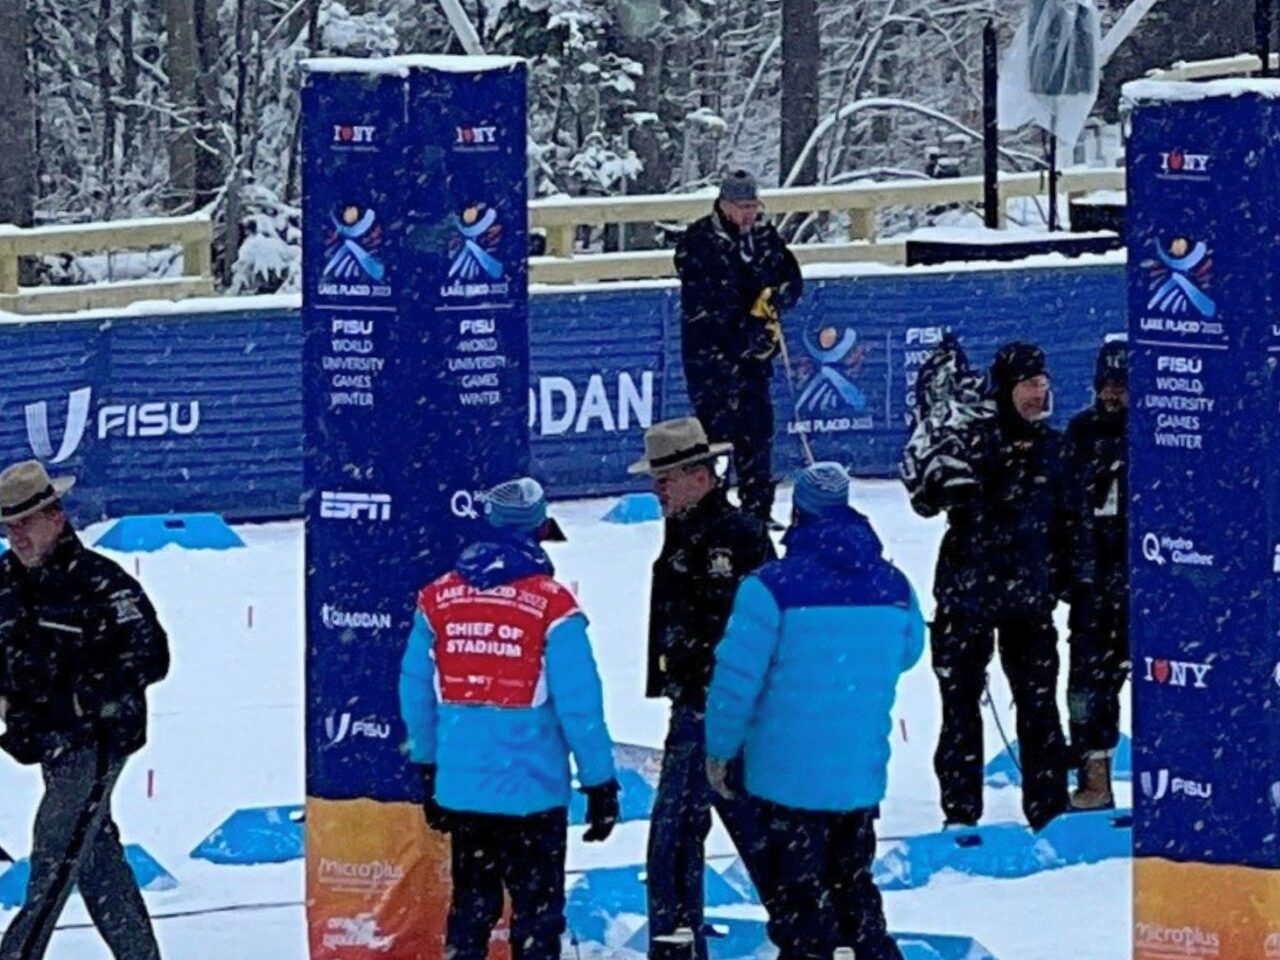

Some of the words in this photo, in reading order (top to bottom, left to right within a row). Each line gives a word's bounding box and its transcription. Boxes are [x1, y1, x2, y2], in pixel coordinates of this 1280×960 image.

[332, 320, 374, 334] FISU
[459, 320, 496, 334] FISU
[332, 339, 373, 353] WORLD
[1157, 357, 1203, 373] FISU
[332, 374, 372, 388] GAMES
[461, 373, 499, 388] GAMES
[1156, 377, 1203, 393] WORLD
[459, 391, 501, 406] WINTER
[1146, 394, 1215, 412] UNIVERSITY
[98, 400, 200, 438] FISU
[787, 419, 812, 434] LAKE
[813, 418, 850, 432] PLACID
[1157, 414, 1200, 429] GAMES
[1155, 432, 1202, 449] WINTER
[320, 490, 392, 520] ESPN
[331, 611, 392, 629] QIAODAN
[446, 622, 495, 638] CHIEF
[497, 624, 524, 641] OF
[446, 640, 523, 658] STADIUM
[351, 721, 391, 739] FISU
[1171, 777, 1213, 799] FISU
